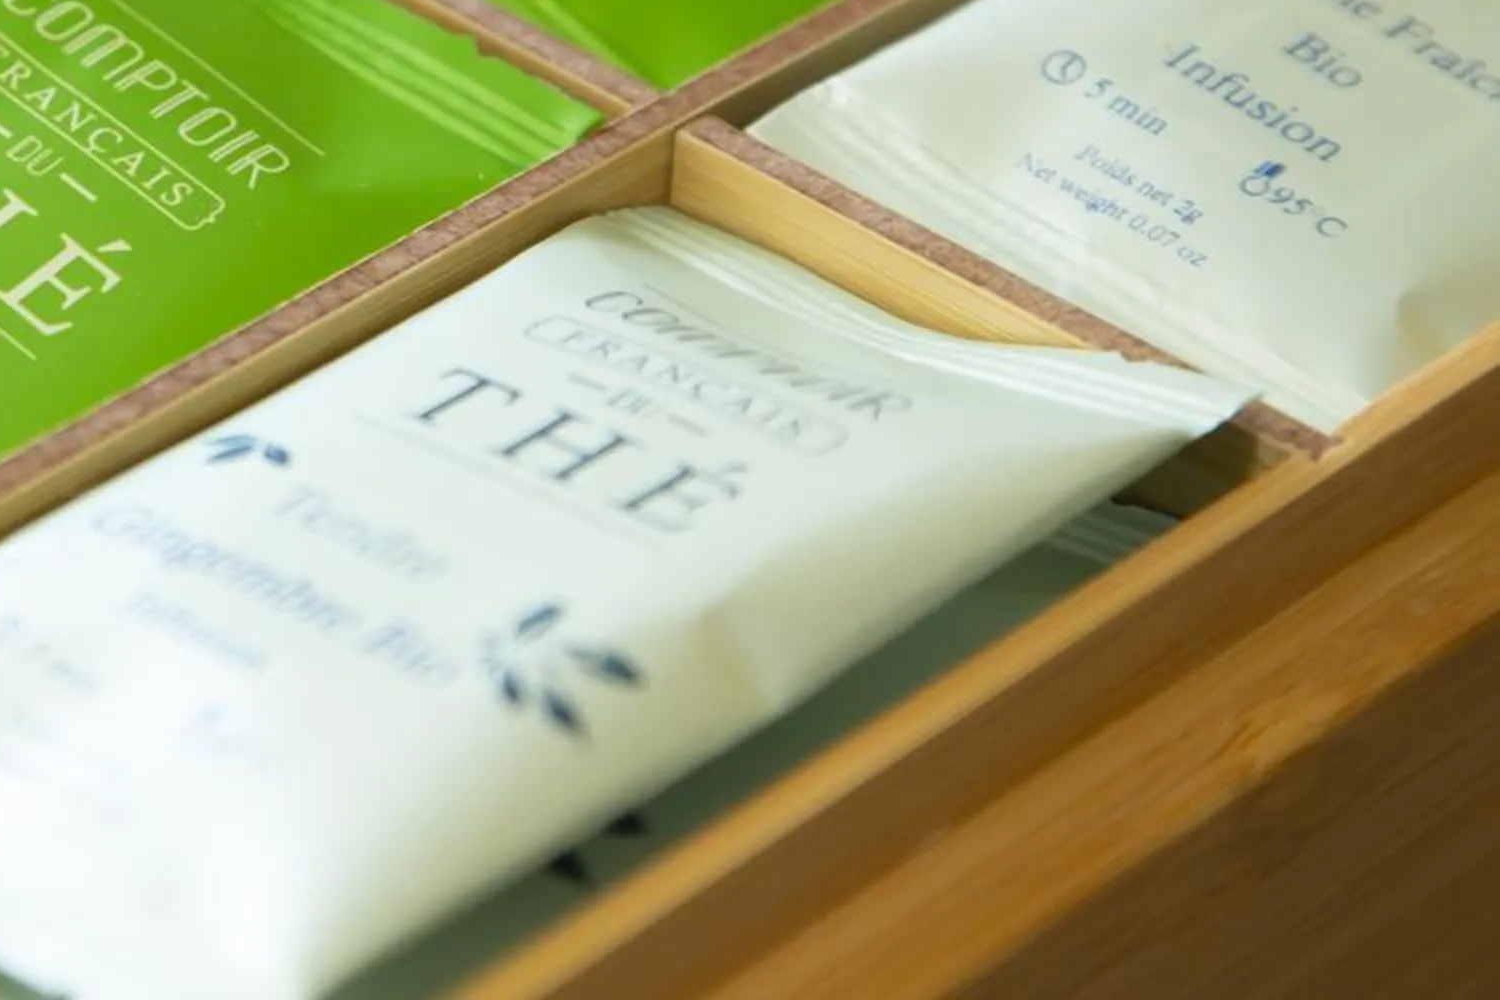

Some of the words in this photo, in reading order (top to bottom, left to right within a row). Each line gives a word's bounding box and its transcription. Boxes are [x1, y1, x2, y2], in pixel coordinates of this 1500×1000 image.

[1163, 43, 1344, 162] Infusion
[1281, 33, 1362, 90] Bio
[1083, 78, 1110, 99] 5
[1106, 94, 1169, 136] min
[6, 137, 63, 177] DU
[1074, 144, 1137, 190] Poids
[1135, 175, 1176, 208] net
[1173, 198, 1204, 227] 2g
[1016, 152, 1059, 185] Net
[1059, 177, 1128, 222] weight
[1128, 213, 1181, 249] 0.07
[408, 367, 748, 535] THÉ
